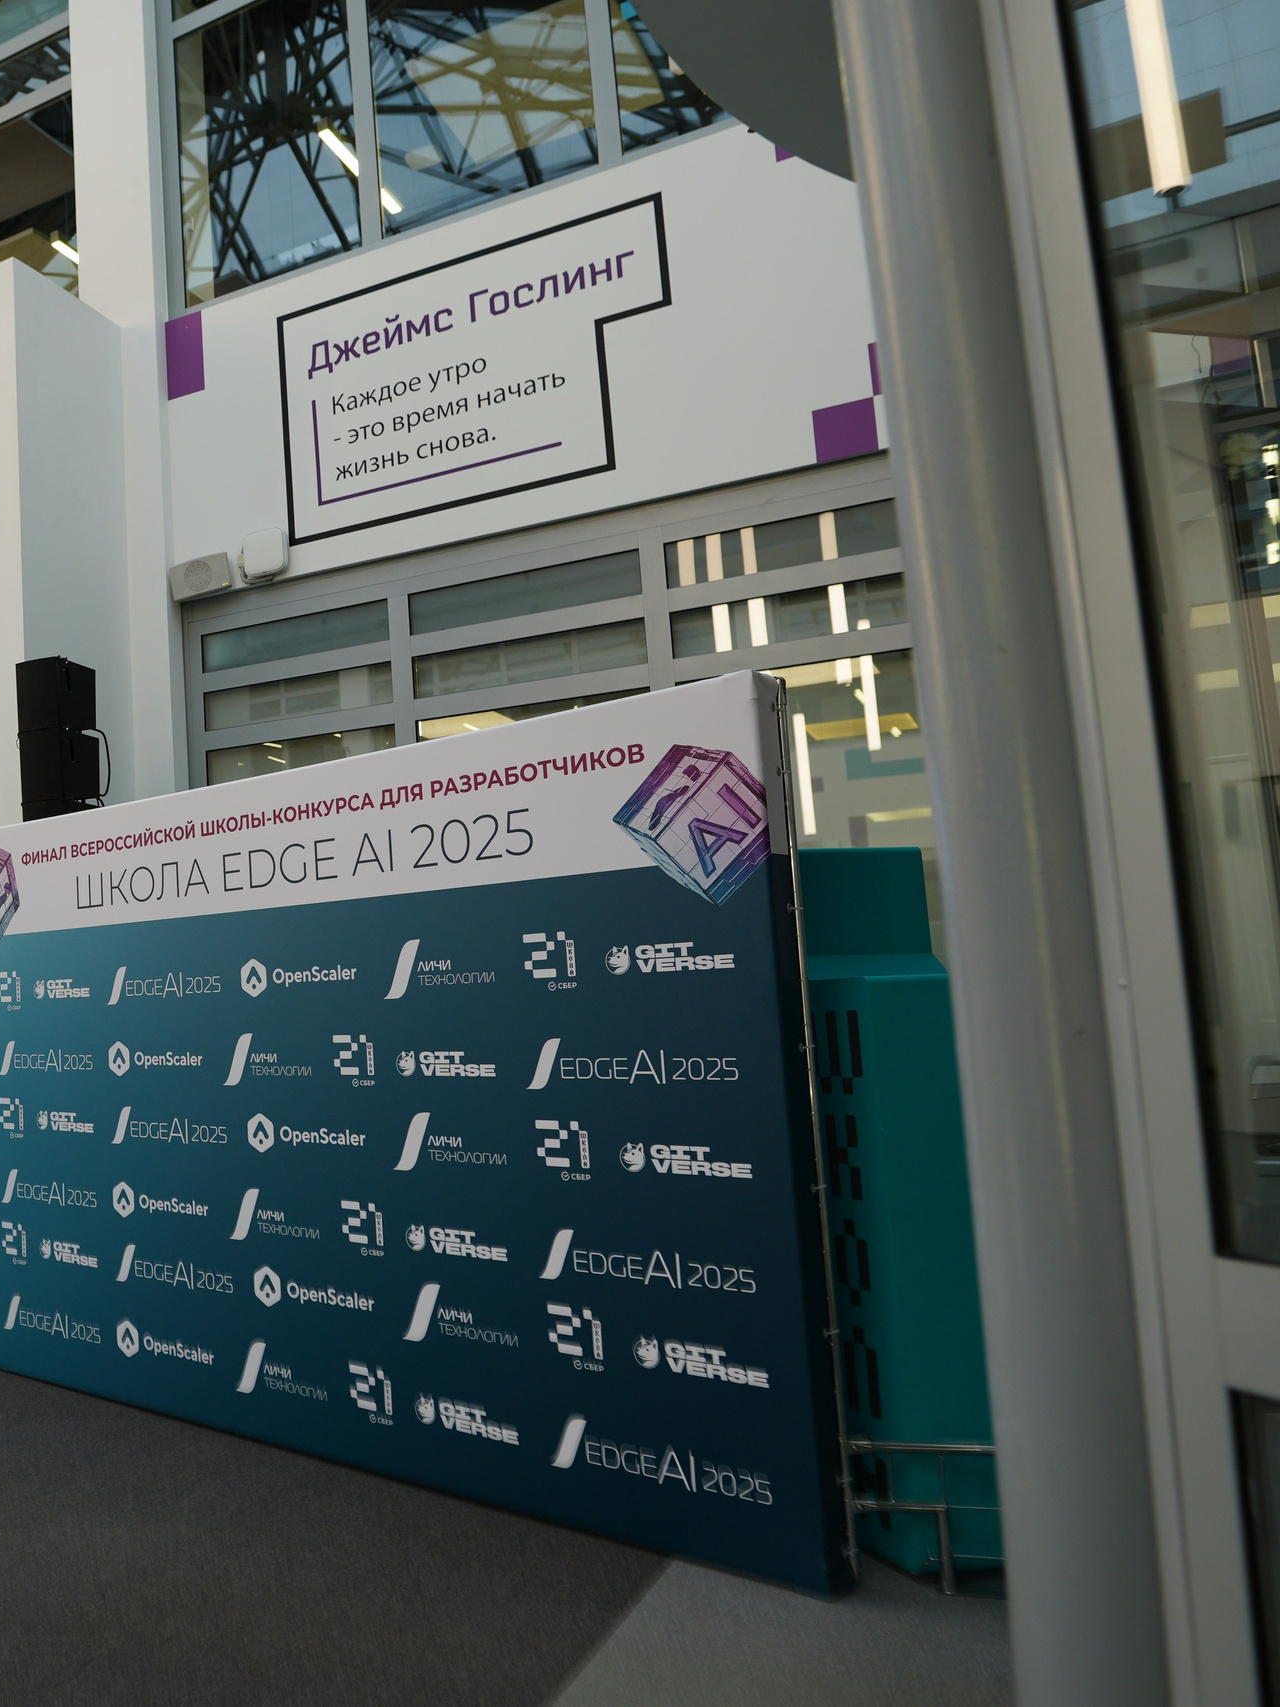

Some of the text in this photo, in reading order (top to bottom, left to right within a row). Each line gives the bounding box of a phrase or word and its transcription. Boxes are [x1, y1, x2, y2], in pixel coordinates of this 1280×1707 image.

[307, 250, 634, 379] Джеймс Гослинг
[331, 357, 487, 416] Каждое утро
[347, 420, 385, 445] это
[392, 399, 469, 434] время
[477, 372, 565, 409] начать
[335, 427, 497, 482] жизнь снова.
[20, 743, 646, 868] ФИНАЛ ВСЕРОССИЙСКОЙ ШКОЛЫ-КОНКУРСА ДЛЯ РАЗРАБОТЧИКОВ
[75, 808, 535, 911] ШКОЛА EDGE AI 2025
[522, 931, 576, 979] 21
[567, 941, 575, 976] ШКОЛА
[635, 941, 694, 959] GIT
[417, 959, 451, 972] ЛИЧИ
[635, 954, 735, 973] VERSE
[47, 978, 73, 988] GIT
[186, 976, 221, 994] 2025
[273, 965, 357, 987] OpenScaler
[418, 972, 495, 986] ТЕХНОЛОГИИ
[47, 987, 90, 999] VERSE
[64, 1054, 93, 1070] 2025
[134, 1051, 203, 1069] OpenScaler
[250, 1053, 277, 1063] ЛИЧИ
[332, 1034, 374, 1075] 21
[419, 1051, 465, 1064] GIT
[251, 1065, 312, 1076] ТЕХНОЛОГИИ
[419, 1064, 496, 1077] VERSE
[672, 1057, 739, 1080] 2025
[0, 1097, 23, 1130] 21
[50, 1111, 76, 1122] GIT
[50, 1122, 94, 1134] VERSE
[191, 1124, 228, 1144] 2025
[280, 1125, 366, 1147] OpenScaler
[428, 1135, 462, 1148] ЛИЧИ
[535, 1119, 590, 1169] 21
[650, 1144, 710, 1161] GIT
[428, 1150, 507, 1165] ТЕХНОЛОГИИ
[571, 1173, 591, 1181] СБЕР
[651, 1159, 753, 1179] VERSE
[67, 1189, 97, 1208] 2025
[139, 1194, 209, 1216] OpenScaler
[257, 1209, 284, 1222] ЛИЧИ
[341, 1200, 384, 1247] 21
[1, 1221, 27, 1257] 21
[257, 1222, 320, 1240] ТЕХНОЛОГИИ
[429, 1227, 475, 1244] GIT
[53, 1241, 80, 1253] GIT
[368, 1249, 384, 1257] СБЕР
[430, 1240, 508, 1262] VERSE
[54, 1252, 98, 1268] VERSE
[197, 1270, 234, 1294] 2025
[688, 1262, 756, 1294] 2025
[287, 1282, 374, 1311] OpenScaler
[437, 1306, 472, 1324] ЛИЧИ
[71, 1321, 101, 1344] 2025
[438, 1322, 519, 1347] ТЕХНОЛОГИИ
[546, 1302, 603, 1360] 21
[143, 1335, 214, 1366] OpenScaler
[664, 1340, 726, 1364] GIT
[264, 1362, 292, 1379] ЛИЧИ
[584, 1363, 604, 1372] СБЕР
[666, 1358, 769, 1388] VERSE
[264, 1377, 328, 1401] ТЕХНОЛОГИИ
[349, 1360, 393, 1415] 21
[439, 1399, 486, 1424] GIT
[440, 1415, 519, 1445] VERSE
[702, 1464, 773, 1505] 2025
